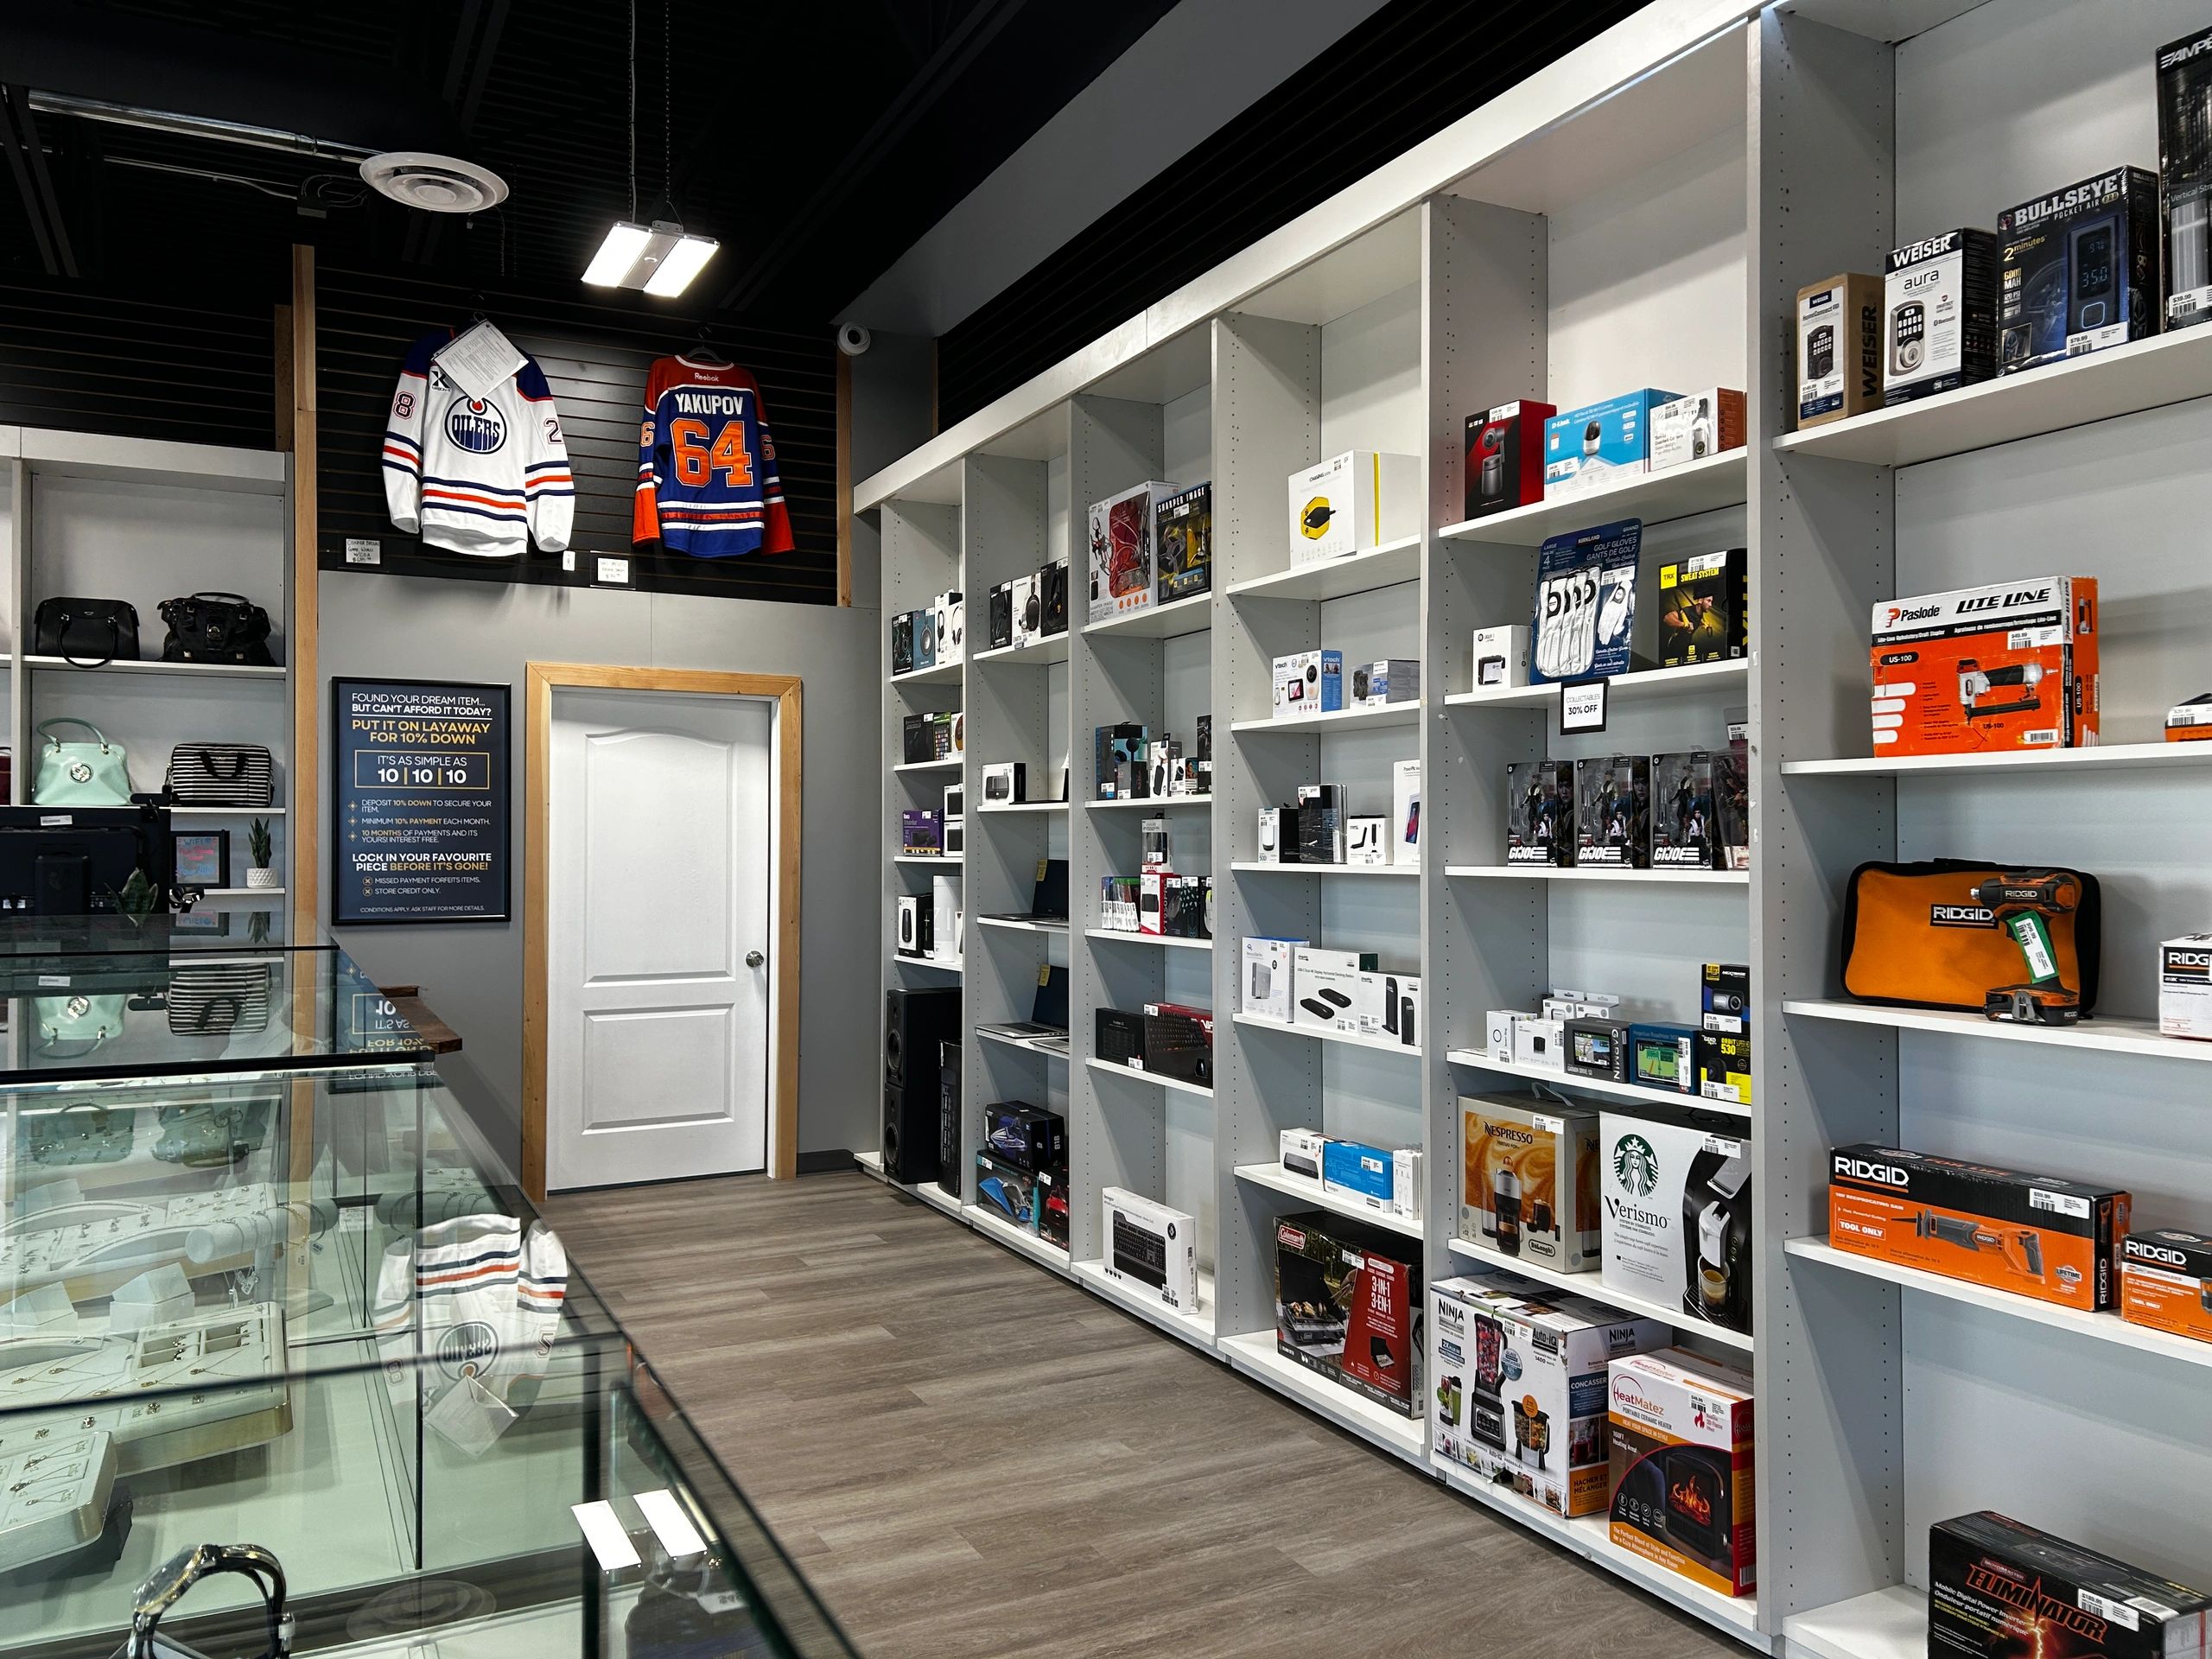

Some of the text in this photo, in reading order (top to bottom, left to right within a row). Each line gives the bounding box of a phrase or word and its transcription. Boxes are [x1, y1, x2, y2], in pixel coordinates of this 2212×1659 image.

[2015, 174, 2118, 226] BULLSEYE
[2171, 188, 2198, 202] Vertical
[2054, 198, 2099, 220] POCKET AIR
[2014, 236, 2045, 251] minutes
[1893, 237, 1952, 268] WEISER
[1904, 270, 1939, 289] aura
[2005, 267, 2022, 280] 6000
[2005, 279, 2021, 290] MAH
[1862, 302, 1877, 397] WEISER
[694, 372, 719, 382] Reebok
[675, 394, 743, 415] YAKUPOV
[1551, 418, 1570, 429] D-Link
[451, 414, 500, 451] OILERS
[671, 417, 753, 487] 64
[1158, 486, 1205, 513] SHARPER IMAGE
[1594, 537, 1637, 551] GOLF GLOVES
[1544, 556, 1550, 565] 4
[1586, 550, 1607, 560] GANTS
[1681, 568, 1719, 582] SWEAT SYSTEM
[1901, 588, 2051, 622] Paslode LITE LINE
[353, 693, 455, 705] FOUND YOUR DREAM
[1566, 694, 1600, 704] COLLECTABLES
[353, 704, 370, 713] BUT
[372, 705, 402, 714] CAN'T
[404, 706, 442, 715] AFFORD
[454, 707, 492, 715] TODAY?
[1584, 704, 1598, 714] OFF
[353, 720, 490, 733] PUT IT ON LAYAWAY
[371, 733, 475, 744] FOR 10% DOWN
[378, 756, 396, 765] IT'S
[415, 757, 451, 766] SIMPLE
[378, 768, 467, 784] 10 10 10
[2005, 890, 2037, 899] RIDGID
[1933, 906, 1994, 922] RIDGID
[1611, 1029, 1620, 1080] GARMIN
[1721, 1044, 1736, 1055] 530
[1484, 1122, 1533, 1144] NESPRESSO
[1835, 1156, 1910, 1185] RIDGID
[1847, 1195, 1889, 1207] RECIPROCATING
[1605, 1196, 1668, 1229] Verismo
[1281, 1228, 1300, 1243] Coleman
[1840, 1221, 1883, 1237] TOOL ONLY
[1976, 1233, 1995, 1243] RIDGID
[1531, 1242, 1553, 1254] DeLonghi
[2126, 1240, 2187, 1265] RIDGID
[2057, 1268, 2081, 1279] LIFETIME
[1372, 1276, 1390, 1297] 3-IN-1
[1371, 1294, 1391, 1314] 3-EN-1
[1439, 1298, 1464, 1323] NINJA
[1609, 1328, 1635, 1343] NINJA
[1571, 1377, 1607, 1389] CONCASSER
[1613, 1383, 1664, 1415] HeatMatez
[1623, 1407, 1640, 1419] PORTABLE
[1658, 1421, 1672, 1430] HEATER
[1573, 1476, 1599, 1487] HACHER
[1935, 1581, 2026, 1625] Mobile Digital Power Inverter
[1966, 1564, 2108, 1645] ELIMINATOR
[1935, 1590, 1964, 1606] Onduleur
[1965, 1605, 1991, 1619] portatif
[1991, 1616, 2029, 1636] numérique
